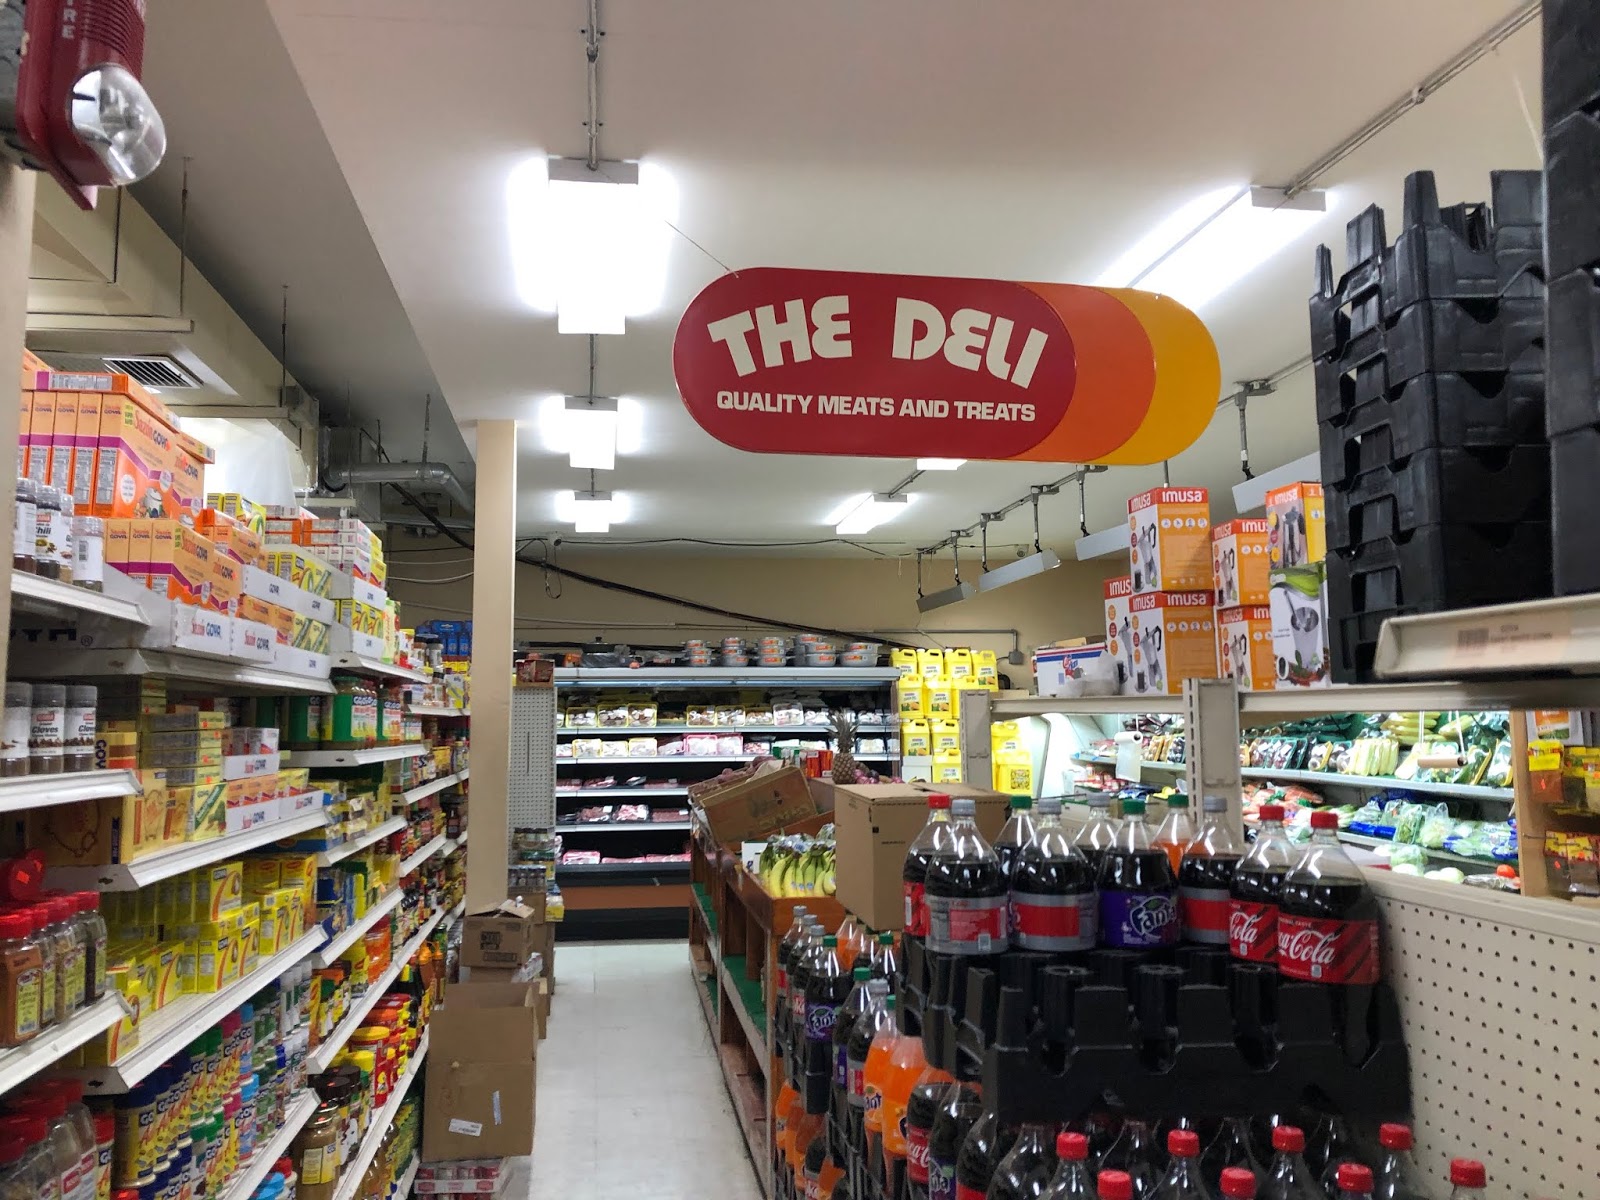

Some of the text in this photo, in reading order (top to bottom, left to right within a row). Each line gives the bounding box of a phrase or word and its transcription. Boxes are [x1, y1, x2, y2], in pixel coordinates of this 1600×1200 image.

[707, 295, 1049, 389] THE DELI
[717, 391, 1036, 422] QUALITY MEATS AND TREATS
[1109, 579, 1131, 596] imus
[31, 726, 59, 734] Cloves
[94, 740, 107, 769] GOY
